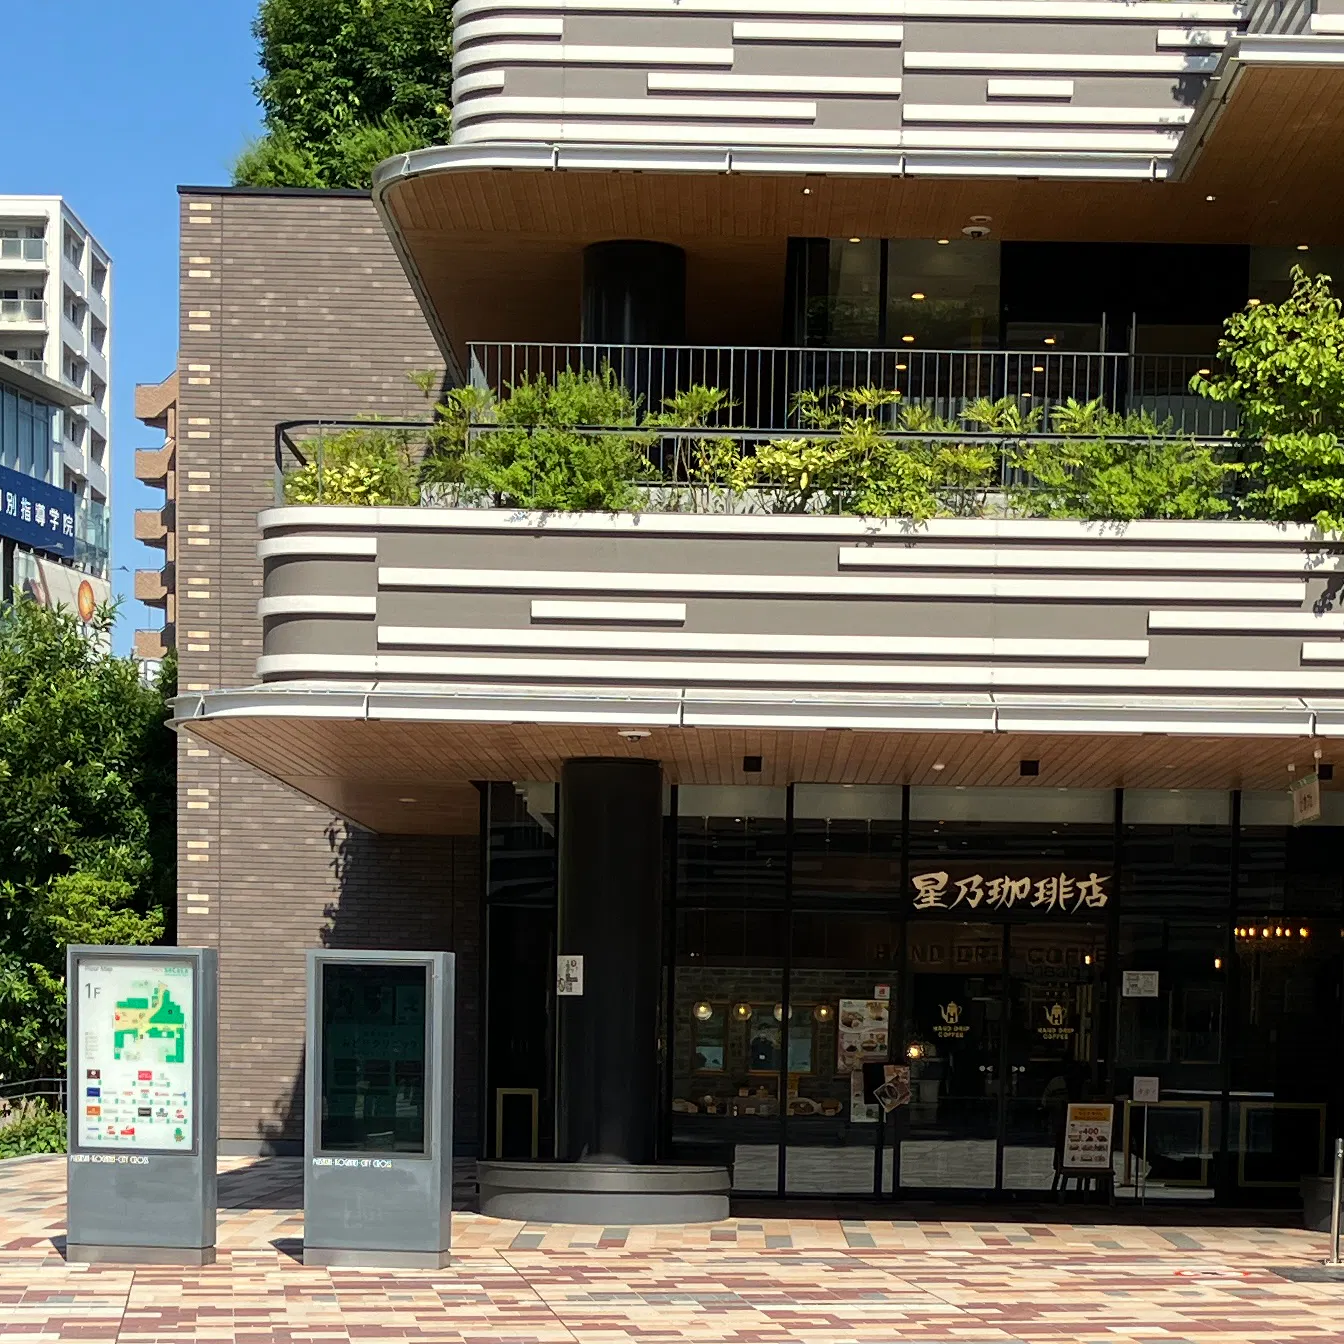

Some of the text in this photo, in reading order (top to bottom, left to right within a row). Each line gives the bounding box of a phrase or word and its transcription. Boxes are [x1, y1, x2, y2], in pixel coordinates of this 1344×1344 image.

[911, 870, 1113, 915] 星乃珈琲店
[85, 982, 101, 999] 1F
